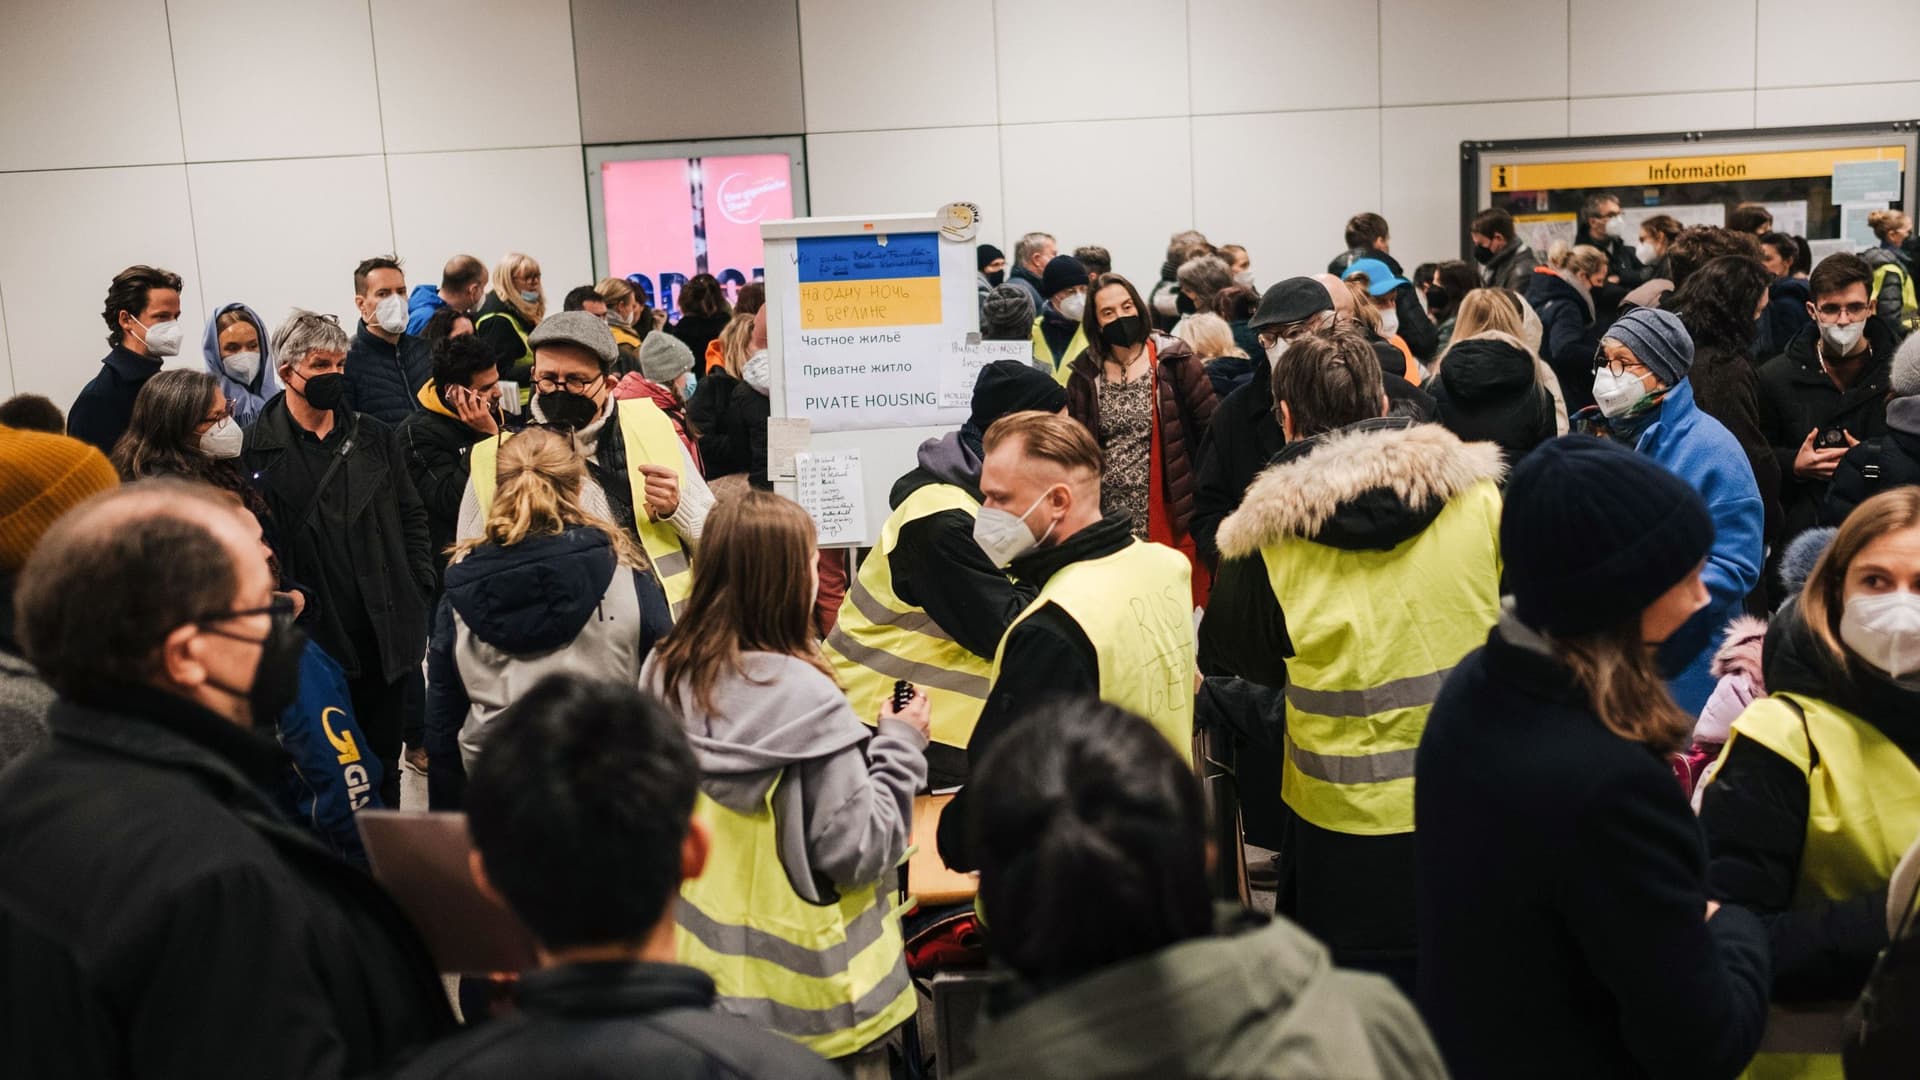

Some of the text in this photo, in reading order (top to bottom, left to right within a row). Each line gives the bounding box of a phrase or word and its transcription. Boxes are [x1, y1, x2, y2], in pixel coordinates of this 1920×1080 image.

[1648, 162, 1747, 181] Information
[801, 331, 902, 346] Частное жильё
[803, 362, 912, 378] Приватне житло
[805, 395, 861, 409] PIVATE
[865, 392, 937, 408] HOUSING
